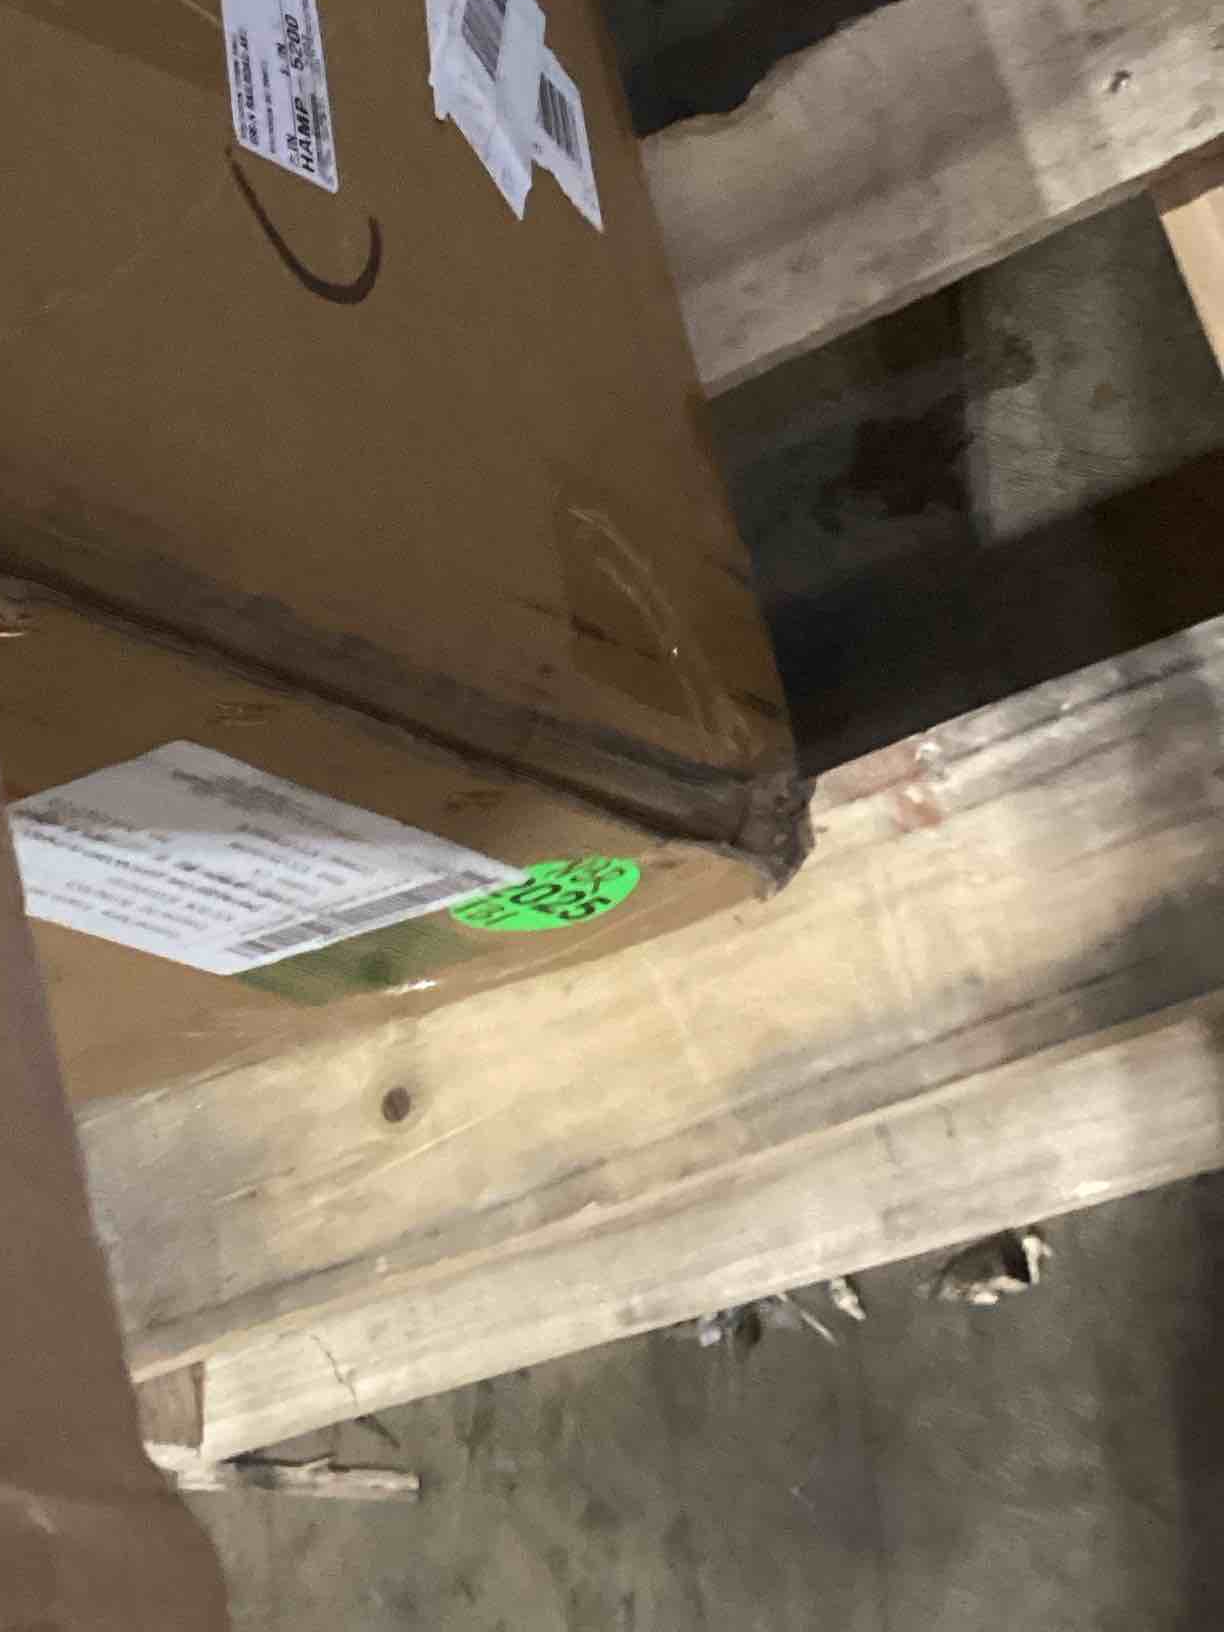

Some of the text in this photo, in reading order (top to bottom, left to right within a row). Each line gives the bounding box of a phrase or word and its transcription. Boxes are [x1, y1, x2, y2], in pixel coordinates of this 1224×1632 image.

[284, 13, 304, 71] 5200
[295, 97, 316, 173] HAMP
[488, 876, 612, 921] 2025
